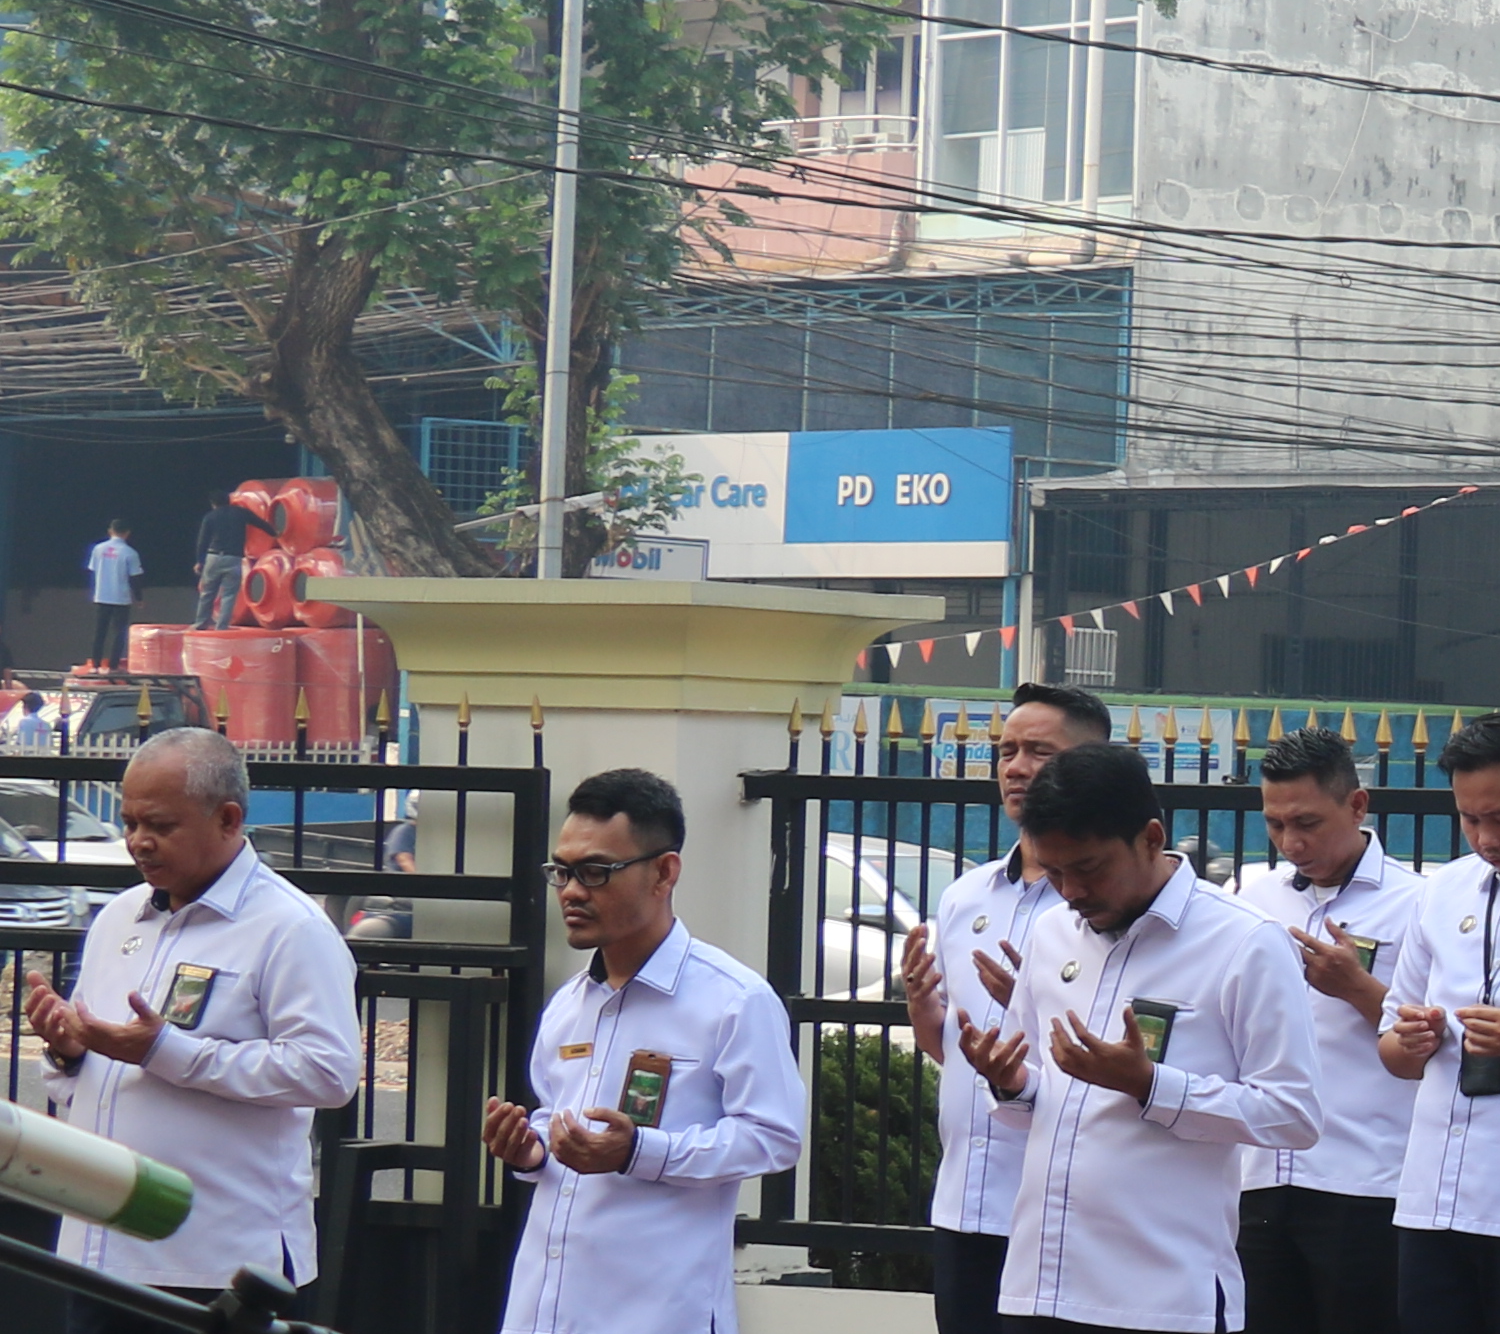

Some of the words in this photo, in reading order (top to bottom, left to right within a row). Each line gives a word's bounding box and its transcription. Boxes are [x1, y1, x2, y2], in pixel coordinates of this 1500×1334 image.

[711, 475, 768, 508] Care
[837, 475, 874, 506] PD
[896, 472, 950, 505] EKO
